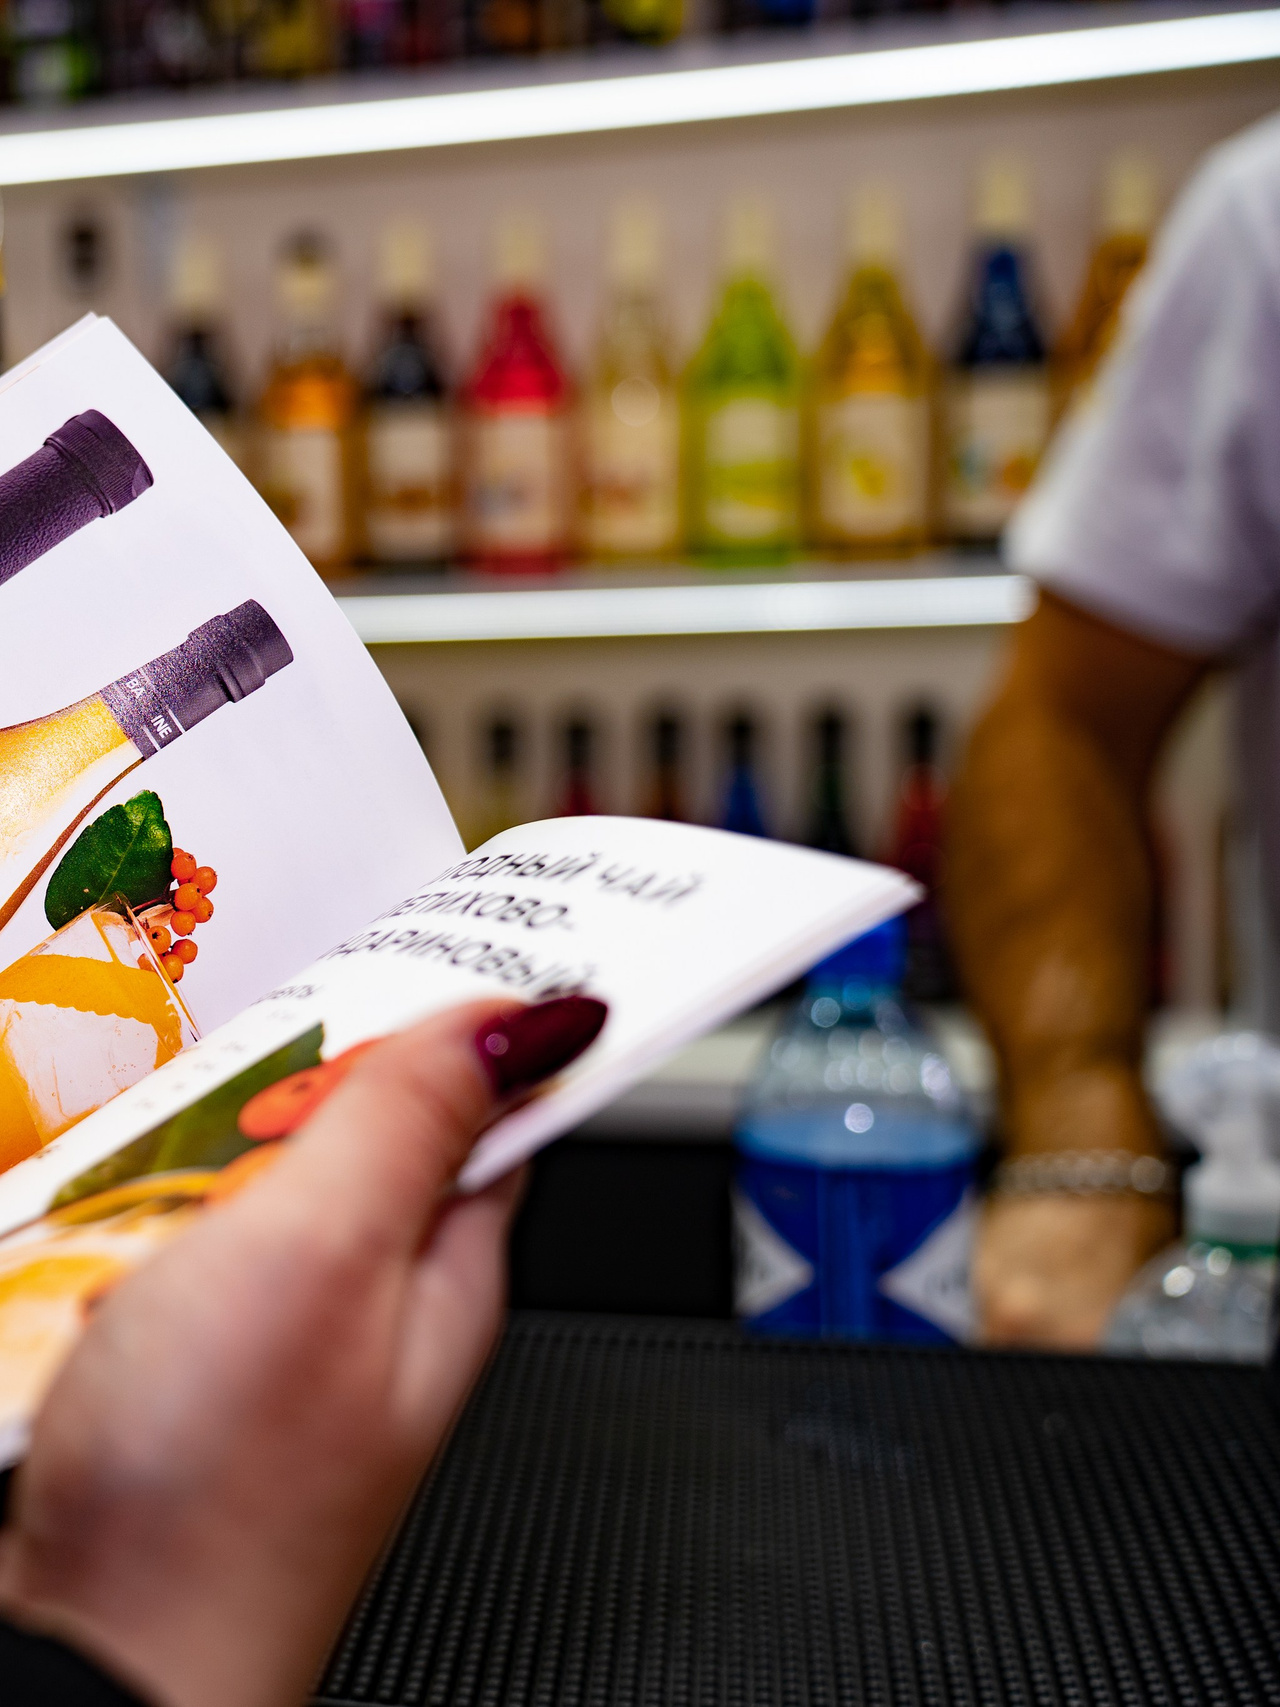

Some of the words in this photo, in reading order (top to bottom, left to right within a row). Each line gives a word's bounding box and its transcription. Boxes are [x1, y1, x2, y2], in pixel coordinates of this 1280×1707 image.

[125, 676, 173, 739] BAINE
[597, 863, 705, 909] ЧАЙ
[360, 891, 576, 932] ЛЕПИХОВО-
